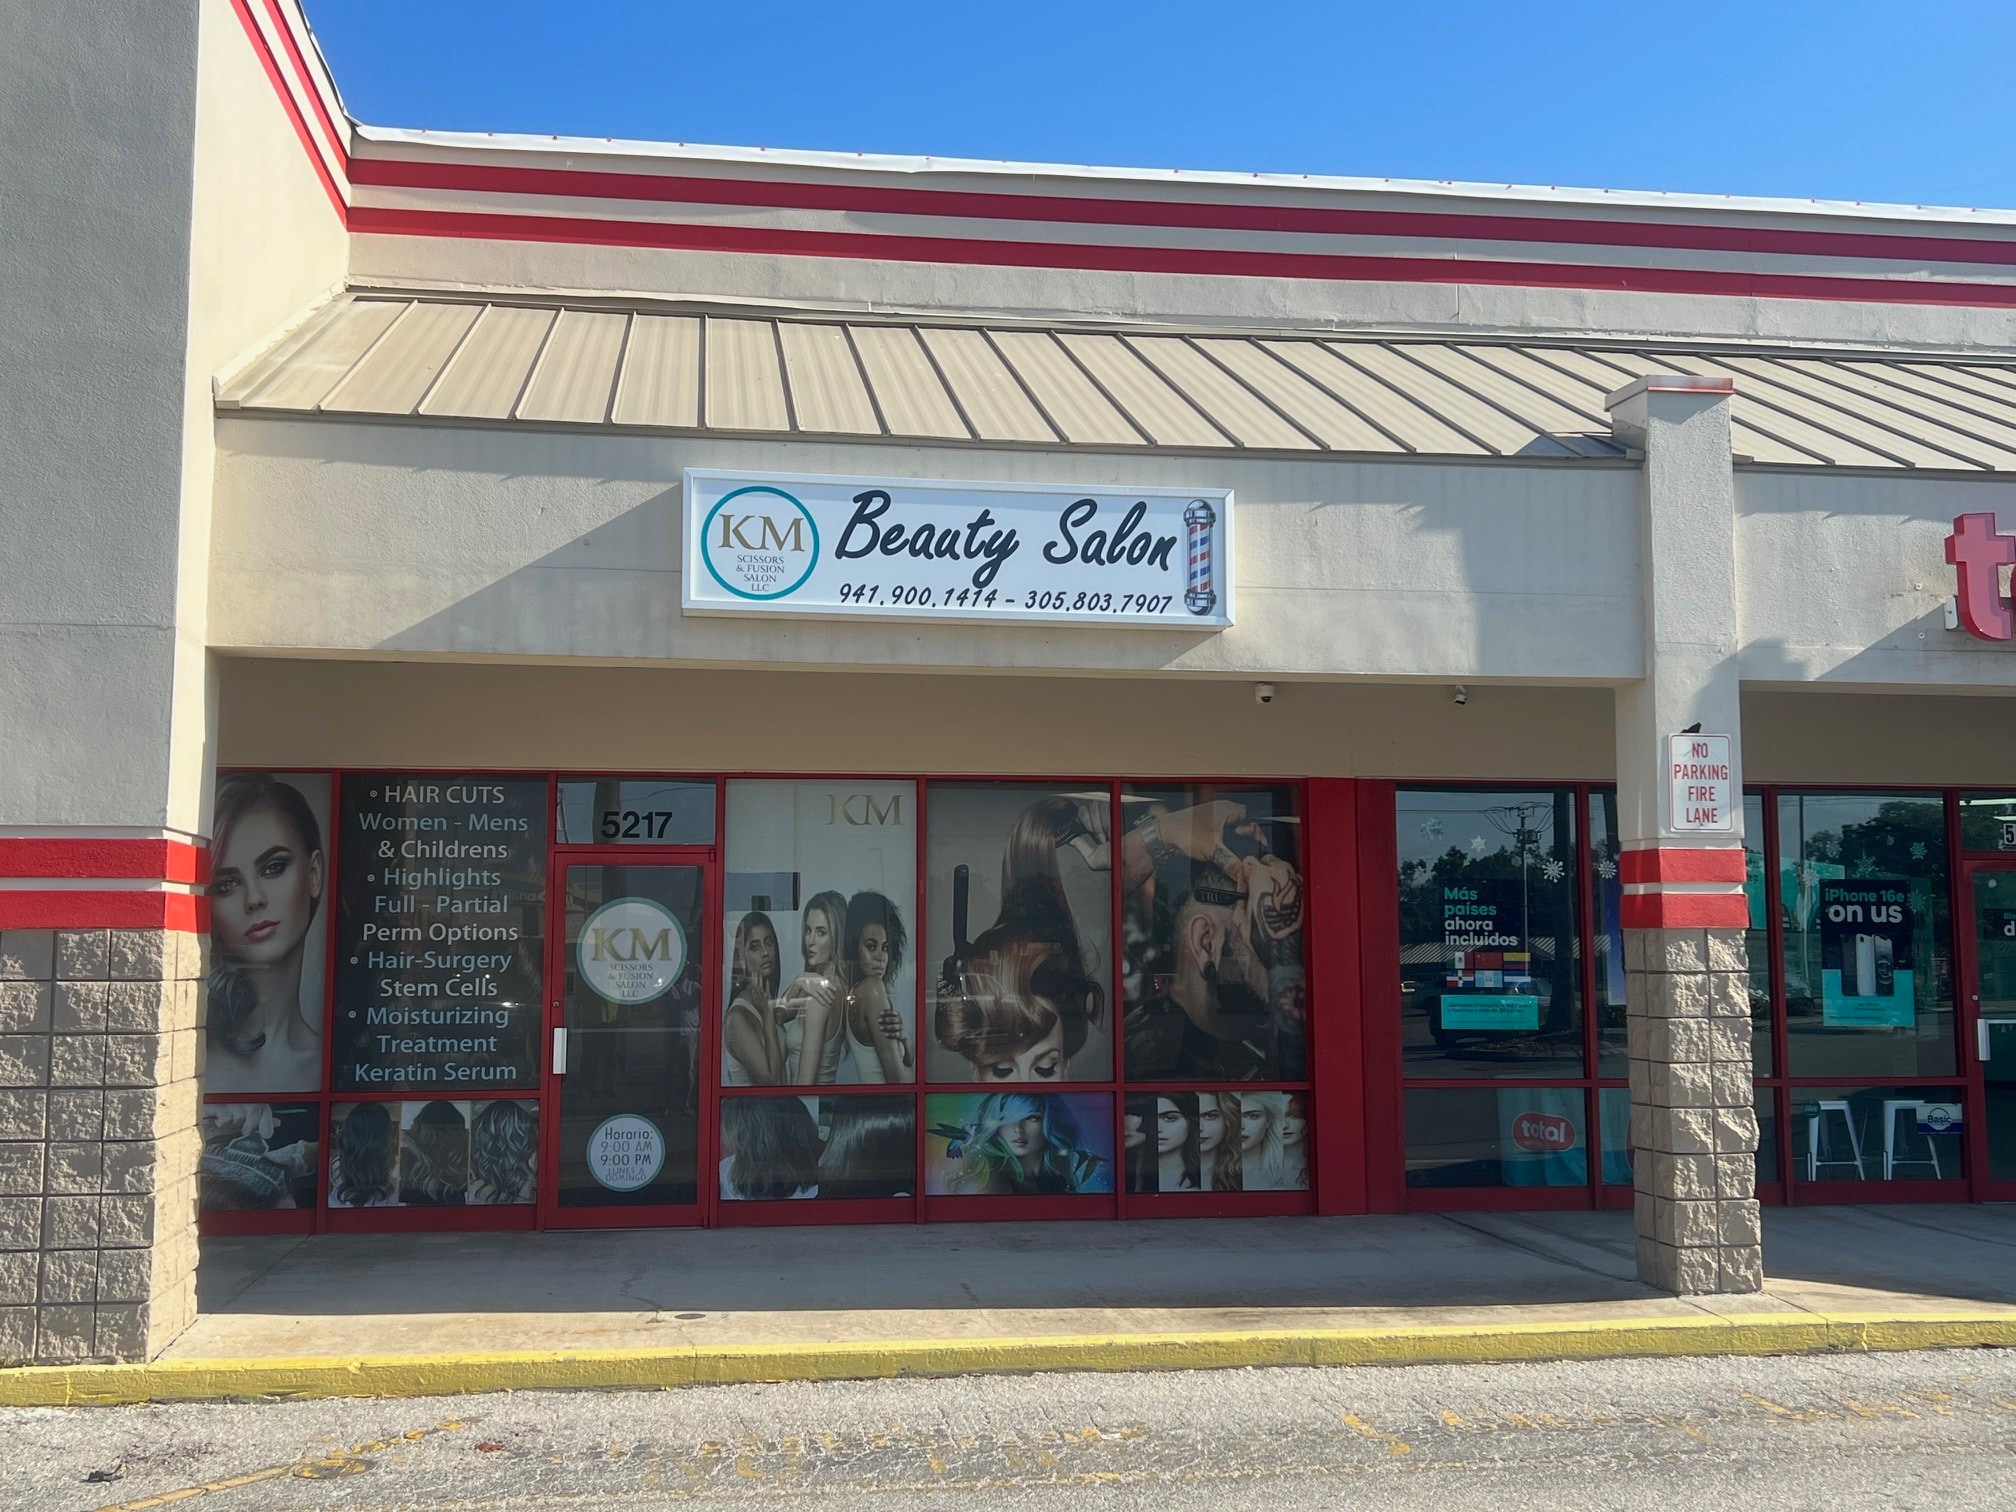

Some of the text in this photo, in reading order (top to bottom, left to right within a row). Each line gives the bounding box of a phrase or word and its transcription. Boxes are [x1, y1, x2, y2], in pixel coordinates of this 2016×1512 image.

[718, 514, 805, 552] KM
[835, 489, 1177, 588] Beauty Salon
[737, 554, 784, 564] SCISSORS
[744, 574, 777, 582] SALON
[747, 564, 785, 574] FUSION
[1944, 512, 2016, 642] t
[751, 584, 770, 592] LLC
[839, 583, 998, 608] 941.900.1414
[1024, 590, 1172, 614] 305.803.7907
[1692, 742, 1708, 758] NO
[1673, 764, 1728, 781] PARKING
[384, 786, 505, 804] HAIR CUTS
[1688, 786, 1716, 802] FIRE
[827, 794, 904, 826] KM
[1686, 806, 1718, 824] LANE
[359, 812, 447, 831] Women
[469, 814, 528, 831] Mens
[600, 811, 673, 839] 5217
[378, 839, 508, 860] & Childrens
[384, 866, 501, 890] Highlights
[1444, 886, 1478, 900] Más
[1825, 888, 1905, 902] iPhone 16e
[375, 896, 415, 914] Full
[436, 896, 508, 914] Partial
[1444, 902, 1497, 918] países
[1828, 904, 1903, 923] on us
[1444, 916, 1493, 930] ahora
[363, 923, 518, 945] Perm Options
[1445, 931, 1518, 946] incluidos
[591, 928, 672, 962] KM
[368, 951, 512, 973] Hair-Surgery
[609, 963, 654, 972] SCISSORS
[608, 972, 654, 980] & FUSION
[380, 978, 498, 996] Stem Cells
[622, 990, 640, 998] LLC
[366, 1006, 510, 1028] Moisturizing
[376, 1034, 497, 1053] Treatment
[355, 1062, 517, 1082] Keratin Serum
[1927, 1114, 1952, 1124] Basic
[605, 1126, 654, 1140] Horario:
[1521, 1120, 1566, 1143] total
[600, 1140, 652, 1153] 9:00 AM
[600, 1154, 652, 1166] 9:00 PM
[606, 1174, 647, 1182] DOMINGO
